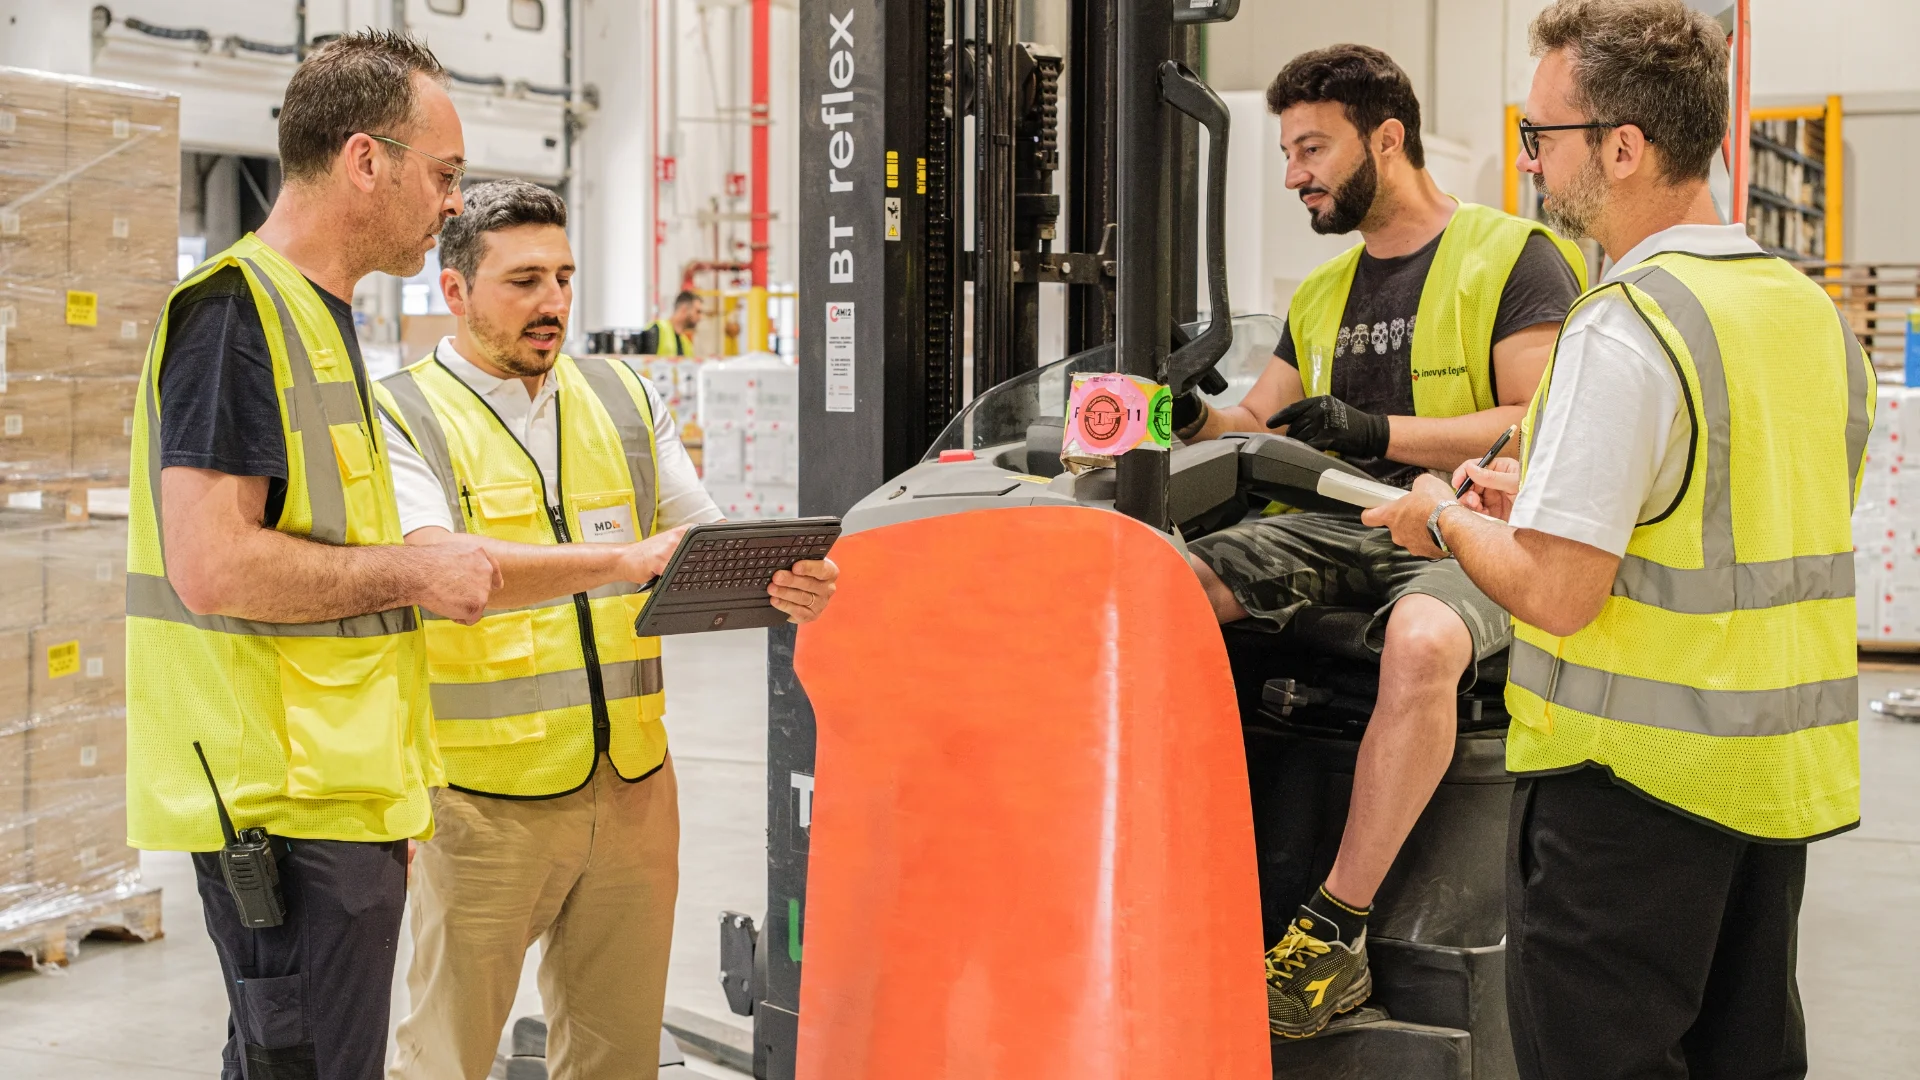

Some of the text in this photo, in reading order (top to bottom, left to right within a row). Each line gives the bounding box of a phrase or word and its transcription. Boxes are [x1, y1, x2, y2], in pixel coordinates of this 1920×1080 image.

[821, 8, 854, 284] BT reflex
[1421, 368, 1447, 378] inovys
